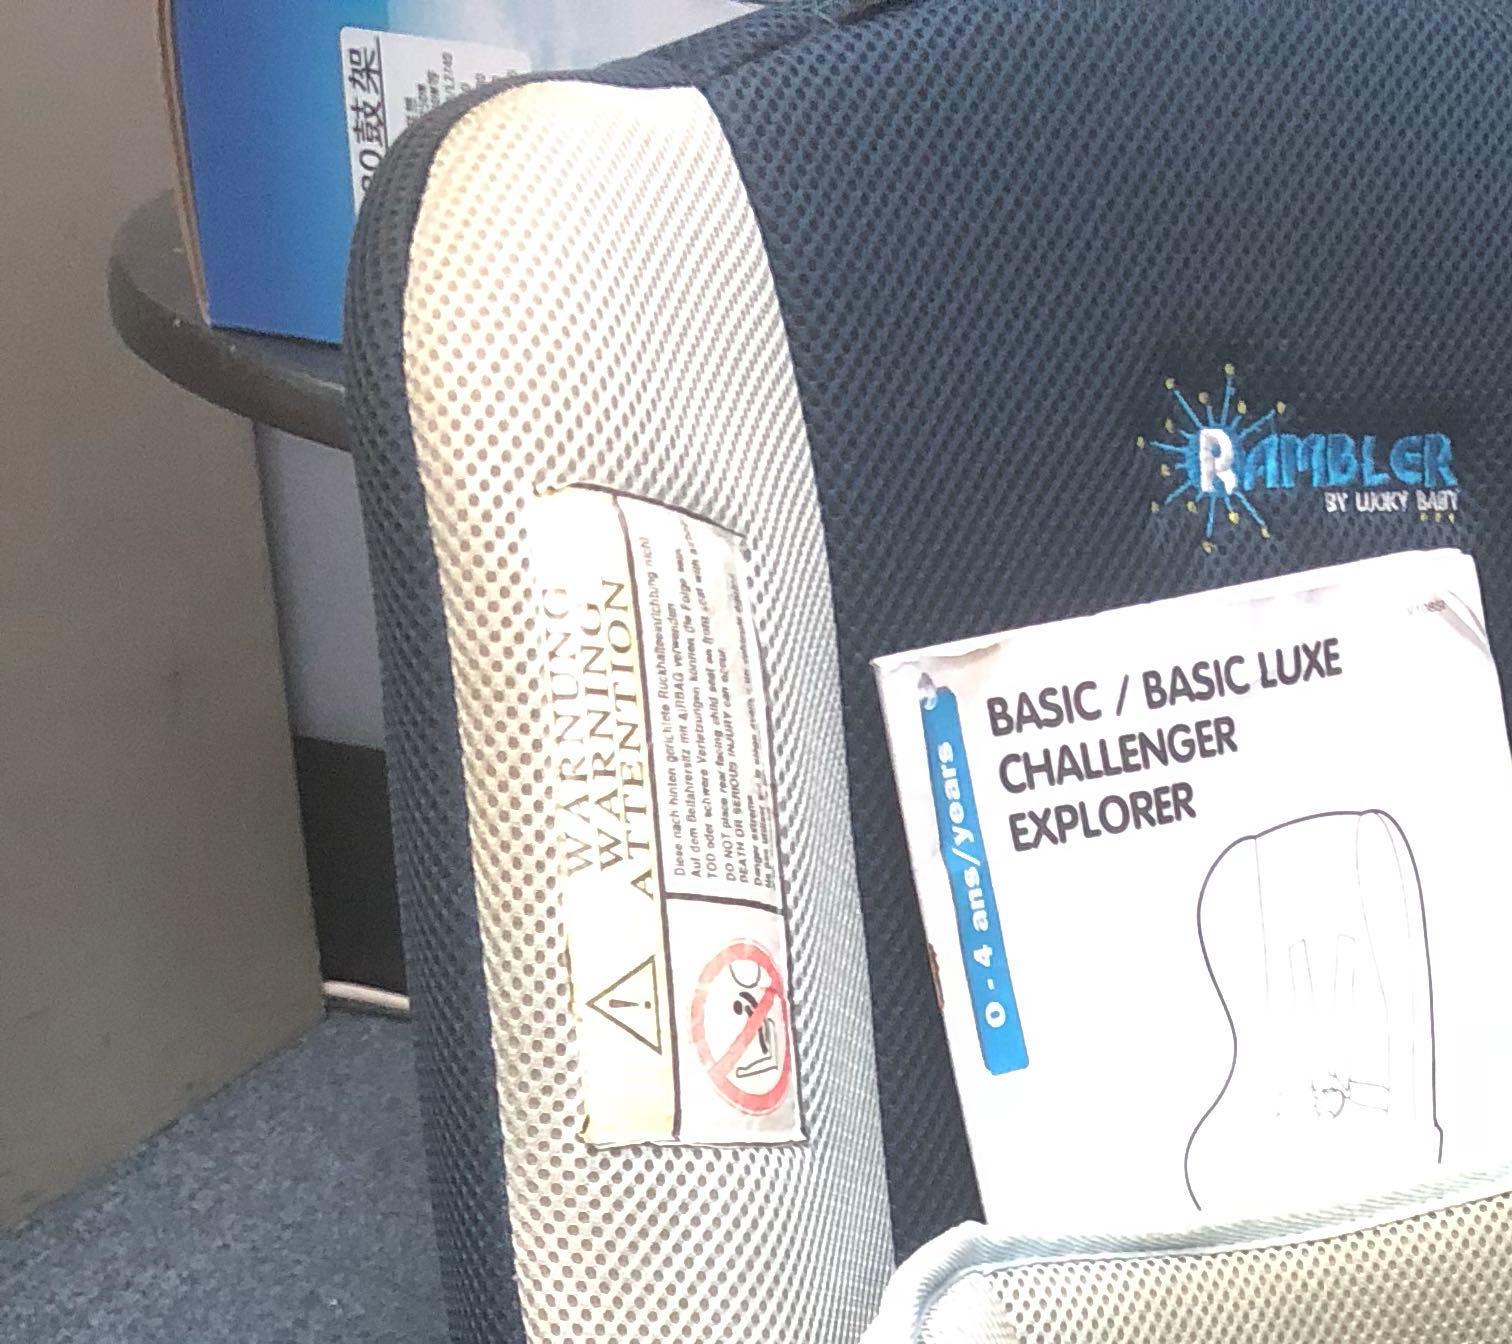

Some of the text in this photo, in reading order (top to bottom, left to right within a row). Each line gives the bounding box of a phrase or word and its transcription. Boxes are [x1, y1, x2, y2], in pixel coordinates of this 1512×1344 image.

[1199, 428, 1458, 494] RAMBLER
[1325, 488, 1460, 513] BY LUCKY BABY
[987, 638, 1344, 737] BASIC / BASIC LUXE
[542, 588, 592, 876] WARNUNG
[580, 603, 623, 870] WARNING
[602, 580, 653, 900] ATTENTION
[999, 716, 1239, 794] CHALLENGER
[669, 810, 681, 838] nach
[690, 828, 700, 853] dem
[721, 832, 733, 858] NOT
[935, 741, 991, 933] ans/years
[1010, 781, 1198, 852] EXPLORER
[706, 853, 718, 879] TOD
[973, 945, 993, 970] 4
